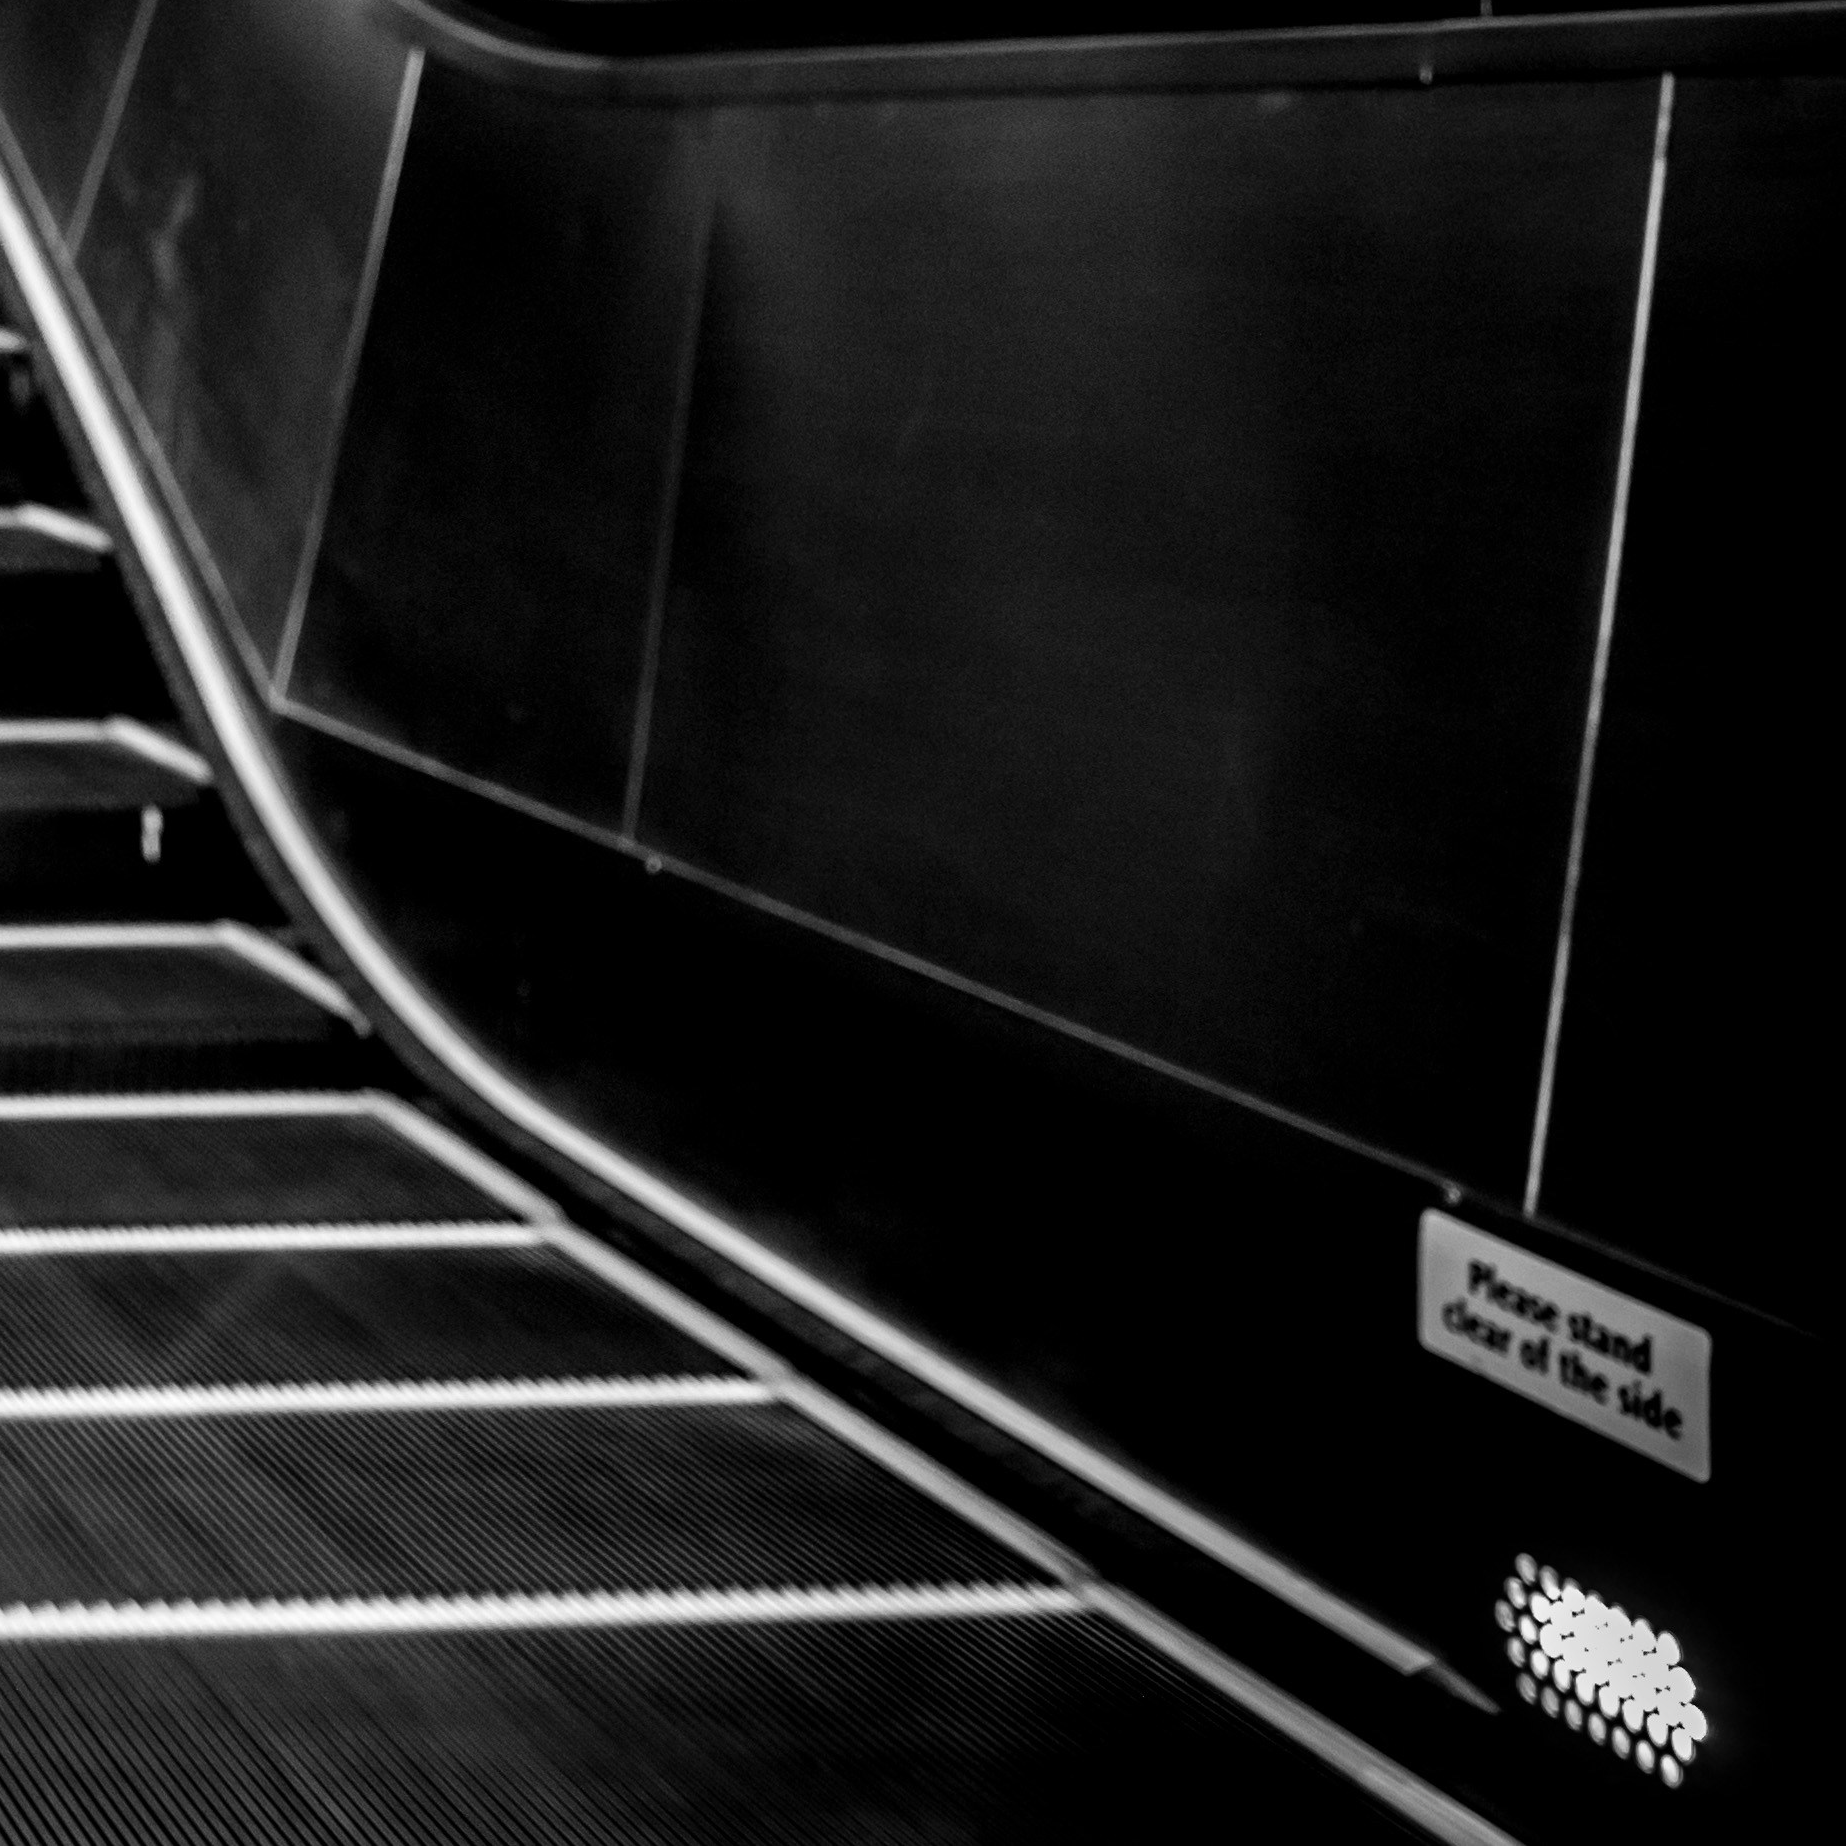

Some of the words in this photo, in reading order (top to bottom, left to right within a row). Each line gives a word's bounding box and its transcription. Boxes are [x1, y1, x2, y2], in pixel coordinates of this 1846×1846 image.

[1440, 1296, 1512, 1356] clear
[1518, 1337, 1550, 1375] of
[1558, 1352, 1609, 1405] the
[1617, 1381, 1683, 1440] side
[1467, 1258, 1559, 1332] Please
[1567, 1310, 1653, 1375] stand
